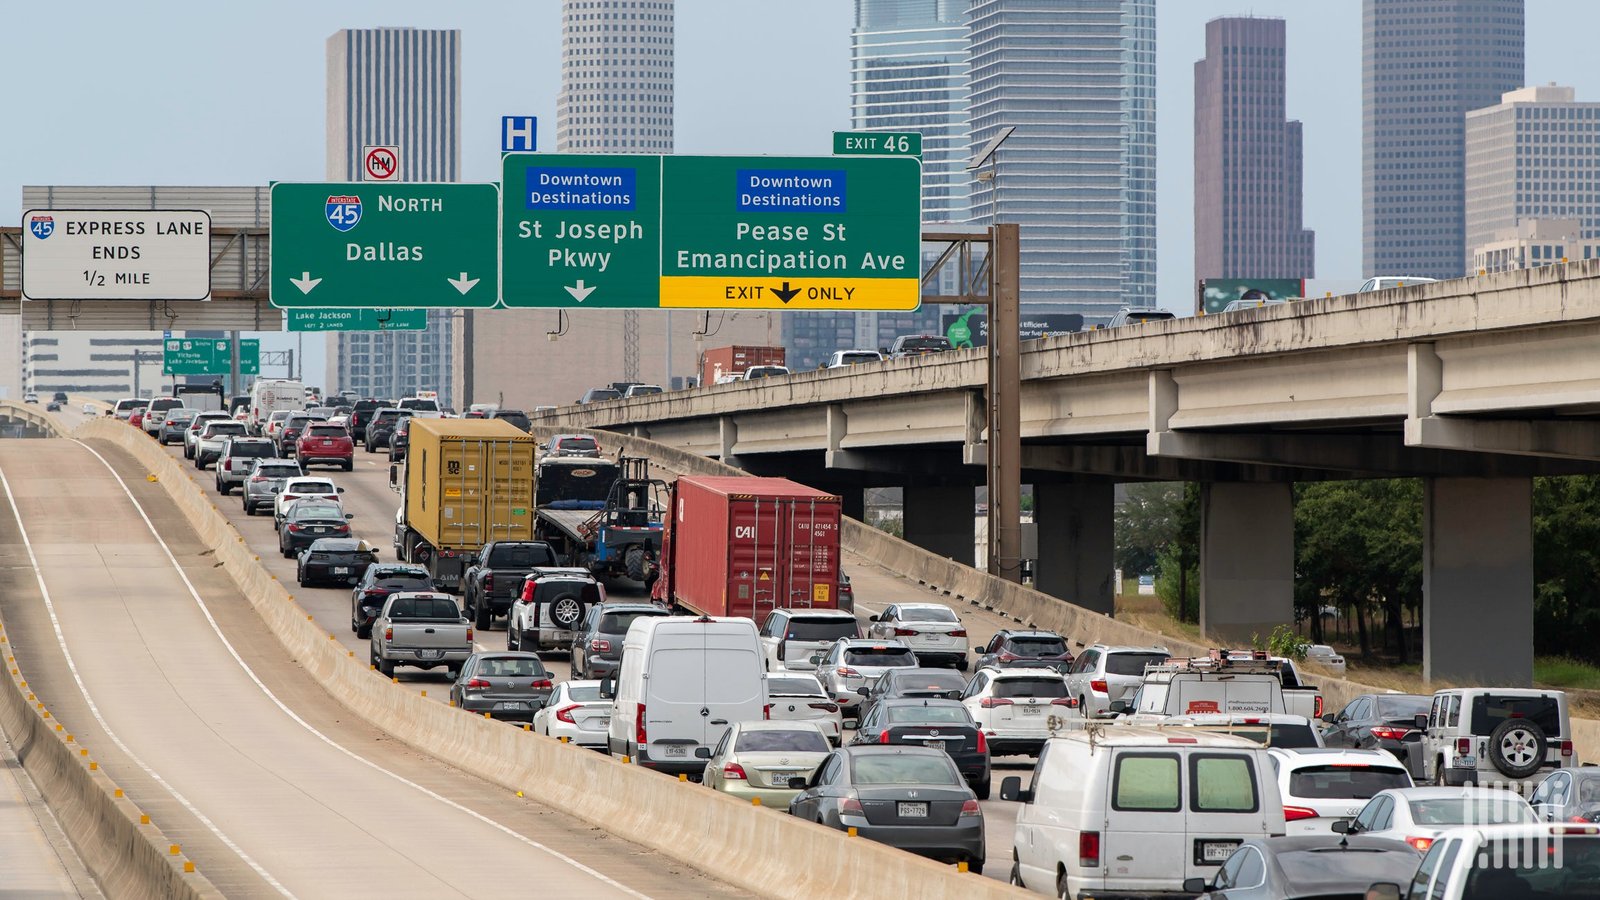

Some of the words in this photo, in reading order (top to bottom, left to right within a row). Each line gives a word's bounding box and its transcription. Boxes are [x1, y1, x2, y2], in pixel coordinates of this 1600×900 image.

[506, 118, 532, 150] H
[845, 137, 877, 150] EXIT
[883, 135, 910, 152] 46
[540, 173, 622, 186] Downtown
[750, 175, 832, 188] Downtown
[531, 191, 630, 205] Destinations
[741, 193, 841, 206] Destinations
[329, 204, 358, 224] 45
[378, 195, 443, 212] NORTH
[33, 222, 52, 235] 45
[66, 221, 145, 235] EXPRESS
[156, 221, 203, 235] LANE
[518, 220, 542, 238] St
[555, 220, 643, 244] Joseph
[736, 222, 809, 241] Pease
[823, 223, 846, 241] St
[93, 246, 141, 260] ENDS
[346, 242, 424, 261] Dallas
[548, 248, 611, 272] Pkwy
[677, 249, 847, 273] Emancipation
[861, 252, 905, 270] Ave
[83, 270, 105, 286] 1/2
[115, 273, 150, 284] MILE
[725, 286, 765, 299] EXIT
[807, 287, 856, 300] ONLY
[319, 312, 352, 320] Jackson
[735, 526, 755, 538] CAI
